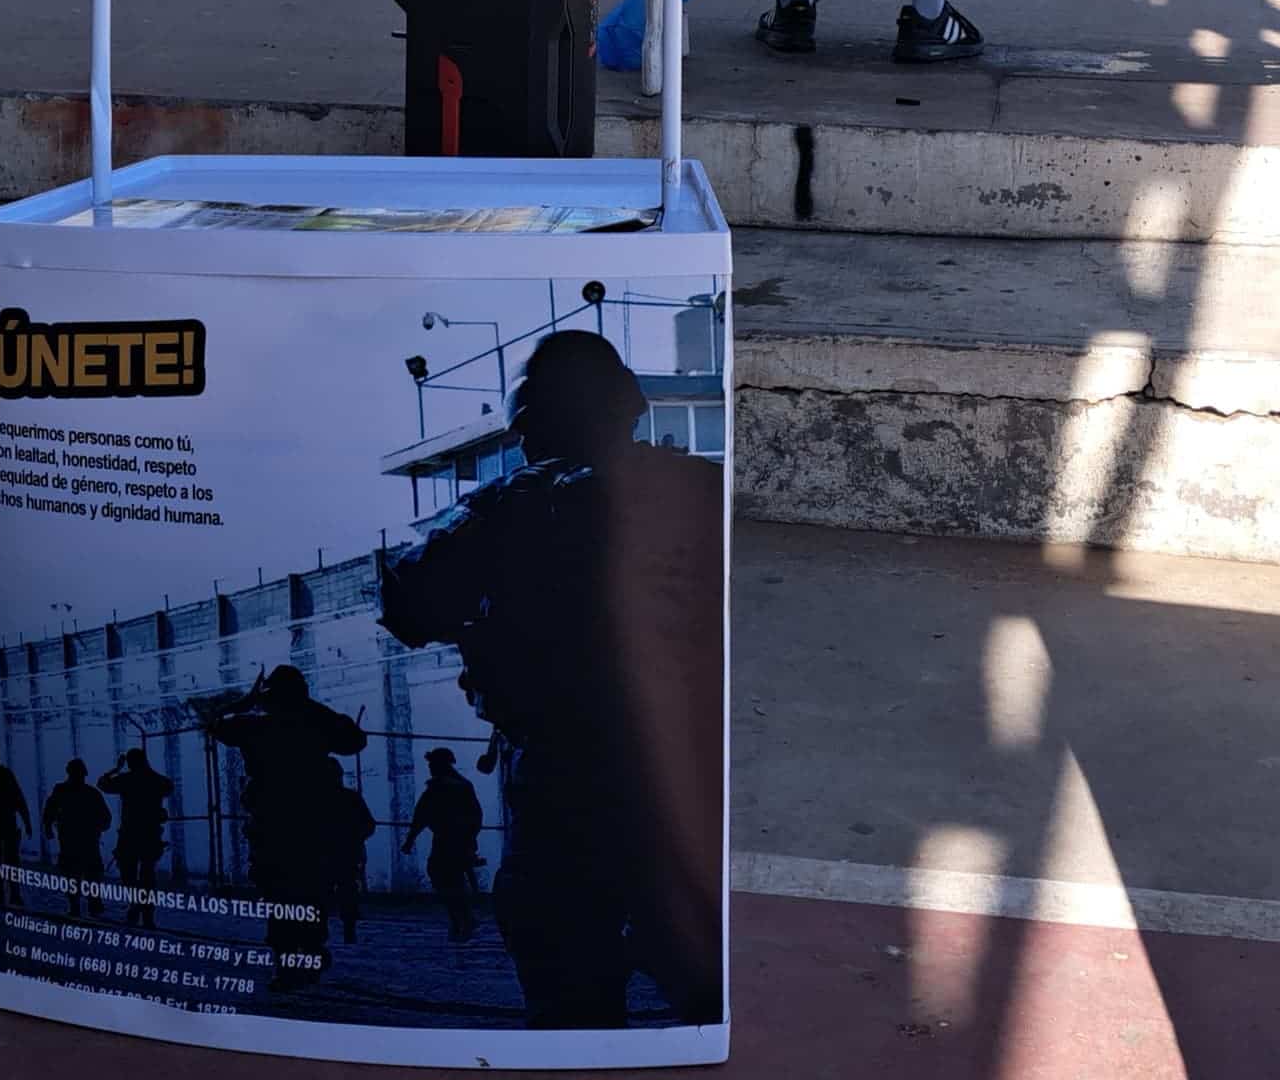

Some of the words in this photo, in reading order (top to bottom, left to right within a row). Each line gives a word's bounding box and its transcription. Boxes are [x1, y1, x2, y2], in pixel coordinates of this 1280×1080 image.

[69, 429, 131, 447] personas
[135, 435, 173, 451] como
[15, 445, 60, 468] lealtad,
[63, 450, 141, 475] honestidad,
[144, 458, 198, 478] respeto
[0, 468, 49, 490] equidad
[125, 481, 178, 501] respeto
[192, 483, 214, 502] los
[26, 493, 87, 516] humanos
[101, 501, 161, 523] dignidad
[164, 508, 224, 527] humana.
[80, 879, 185, 911] COMUNICARSE
[200, 897, 228, 916] LOS
[231, 896, 322, 924] TELÉFONOS:
[5, 910, 58, 937] Culiacán
[60, 924, 94, 946] (667)
[124, 933, 156, 953] 7400
[190, 943, 231, 963] 16798
[279, 952, 323, 971] 16795
[31, 946, 76, 969] Mochis
[79, 957, 113, 978] (668)
